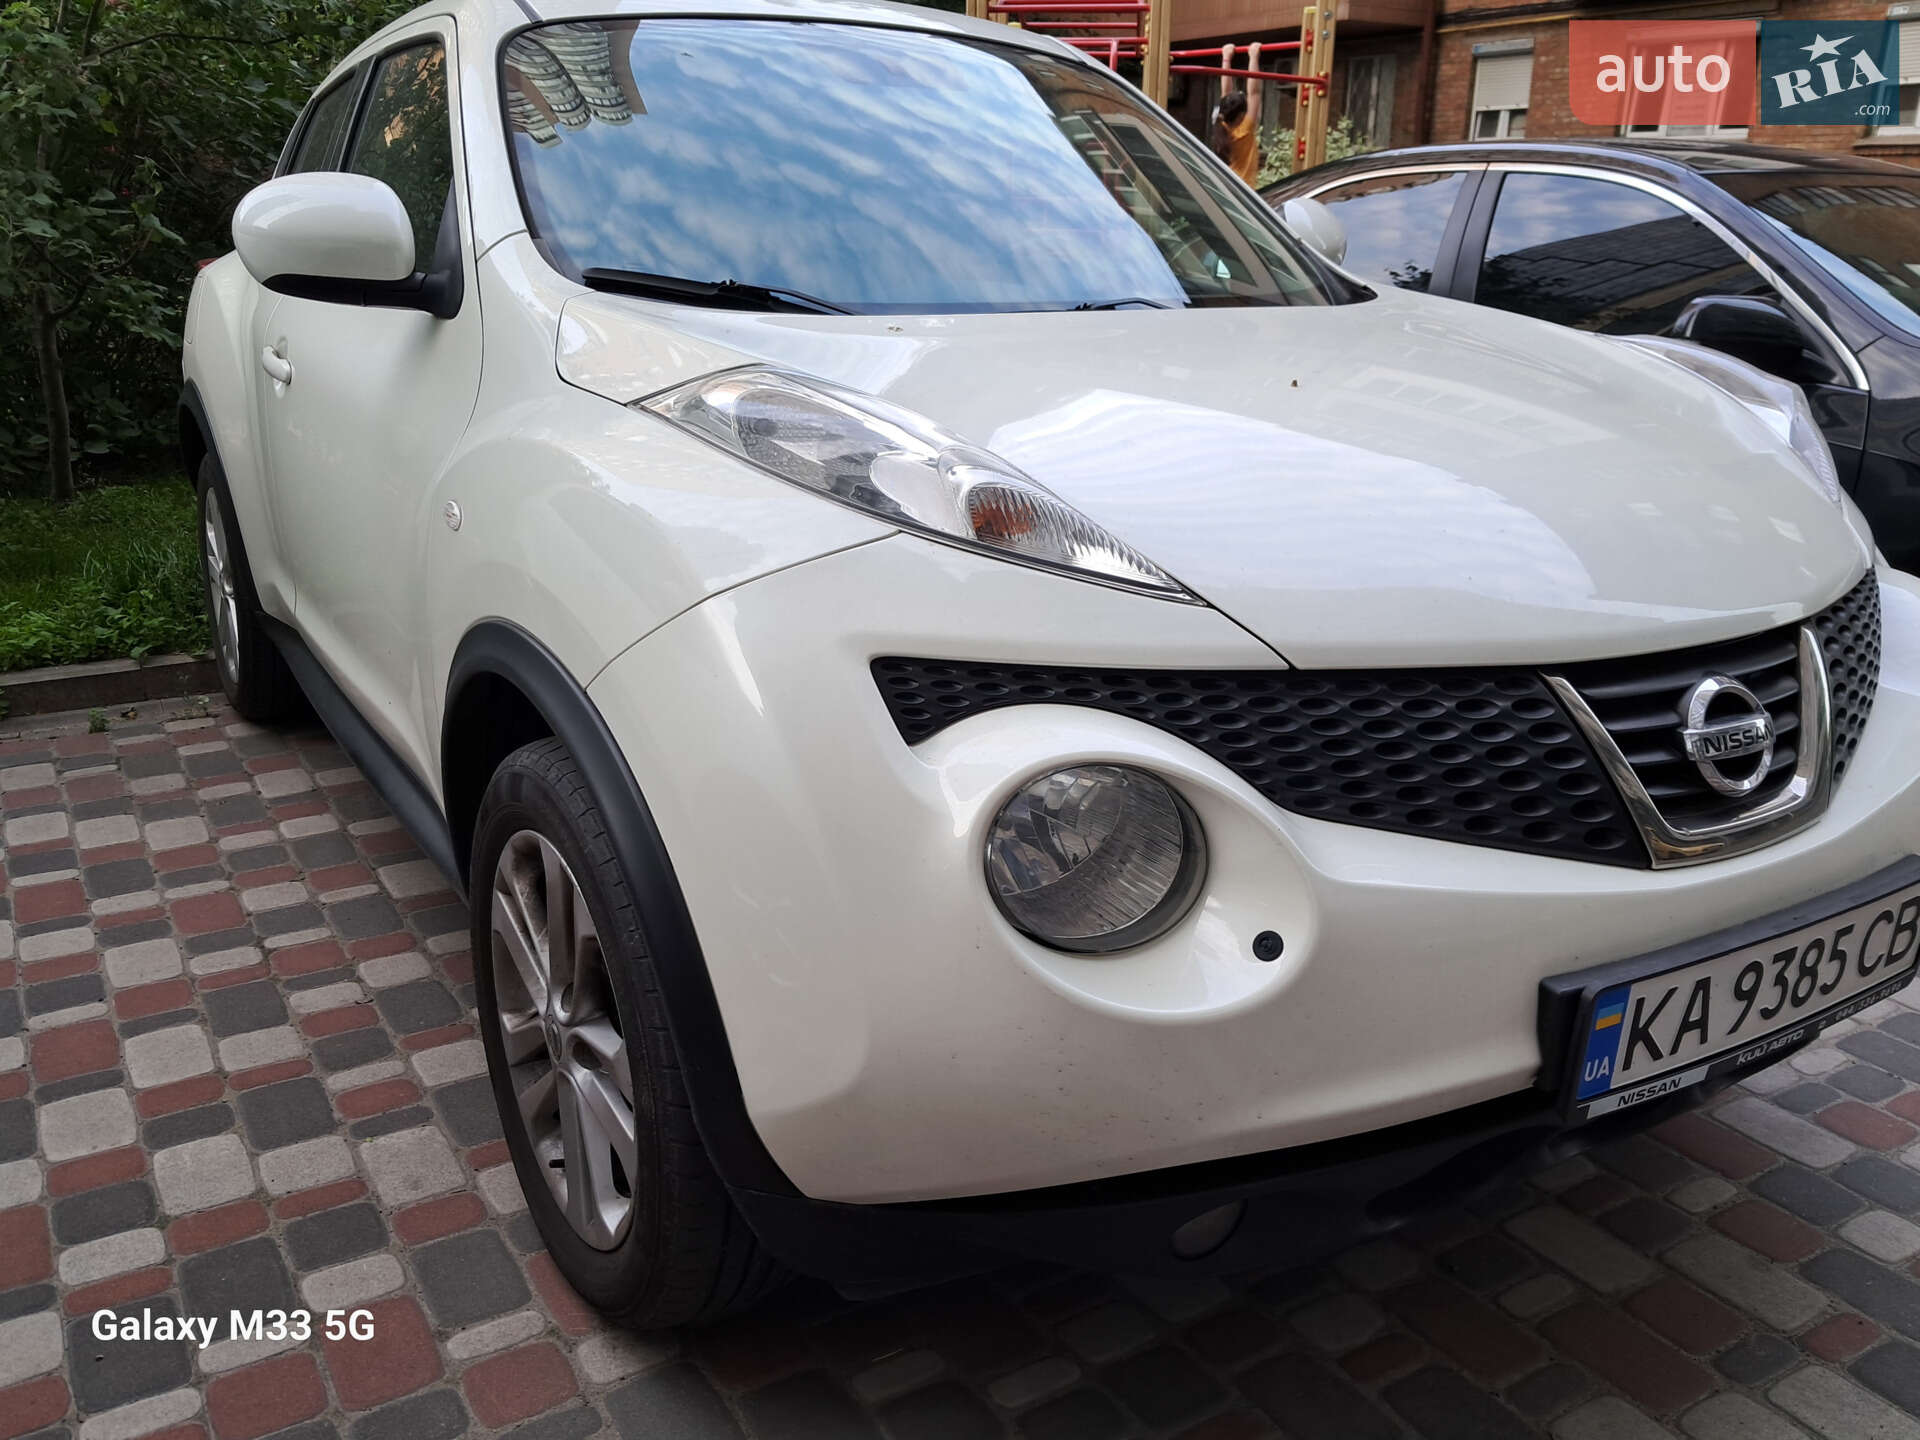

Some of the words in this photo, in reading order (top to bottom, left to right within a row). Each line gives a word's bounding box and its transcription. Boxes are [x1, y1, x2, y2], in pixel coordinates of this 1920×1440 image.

[1703, 725, 1774, 755] NISSAN
[1621, 976, 1712, 1073] KA
[1727, 923, 1855, 1036] 9385
[1858, 896, 1920, 977] CB
[1584, 1058, 1611, 1083] UA
[1617, 1077, 1682, 1107] NISSAN
